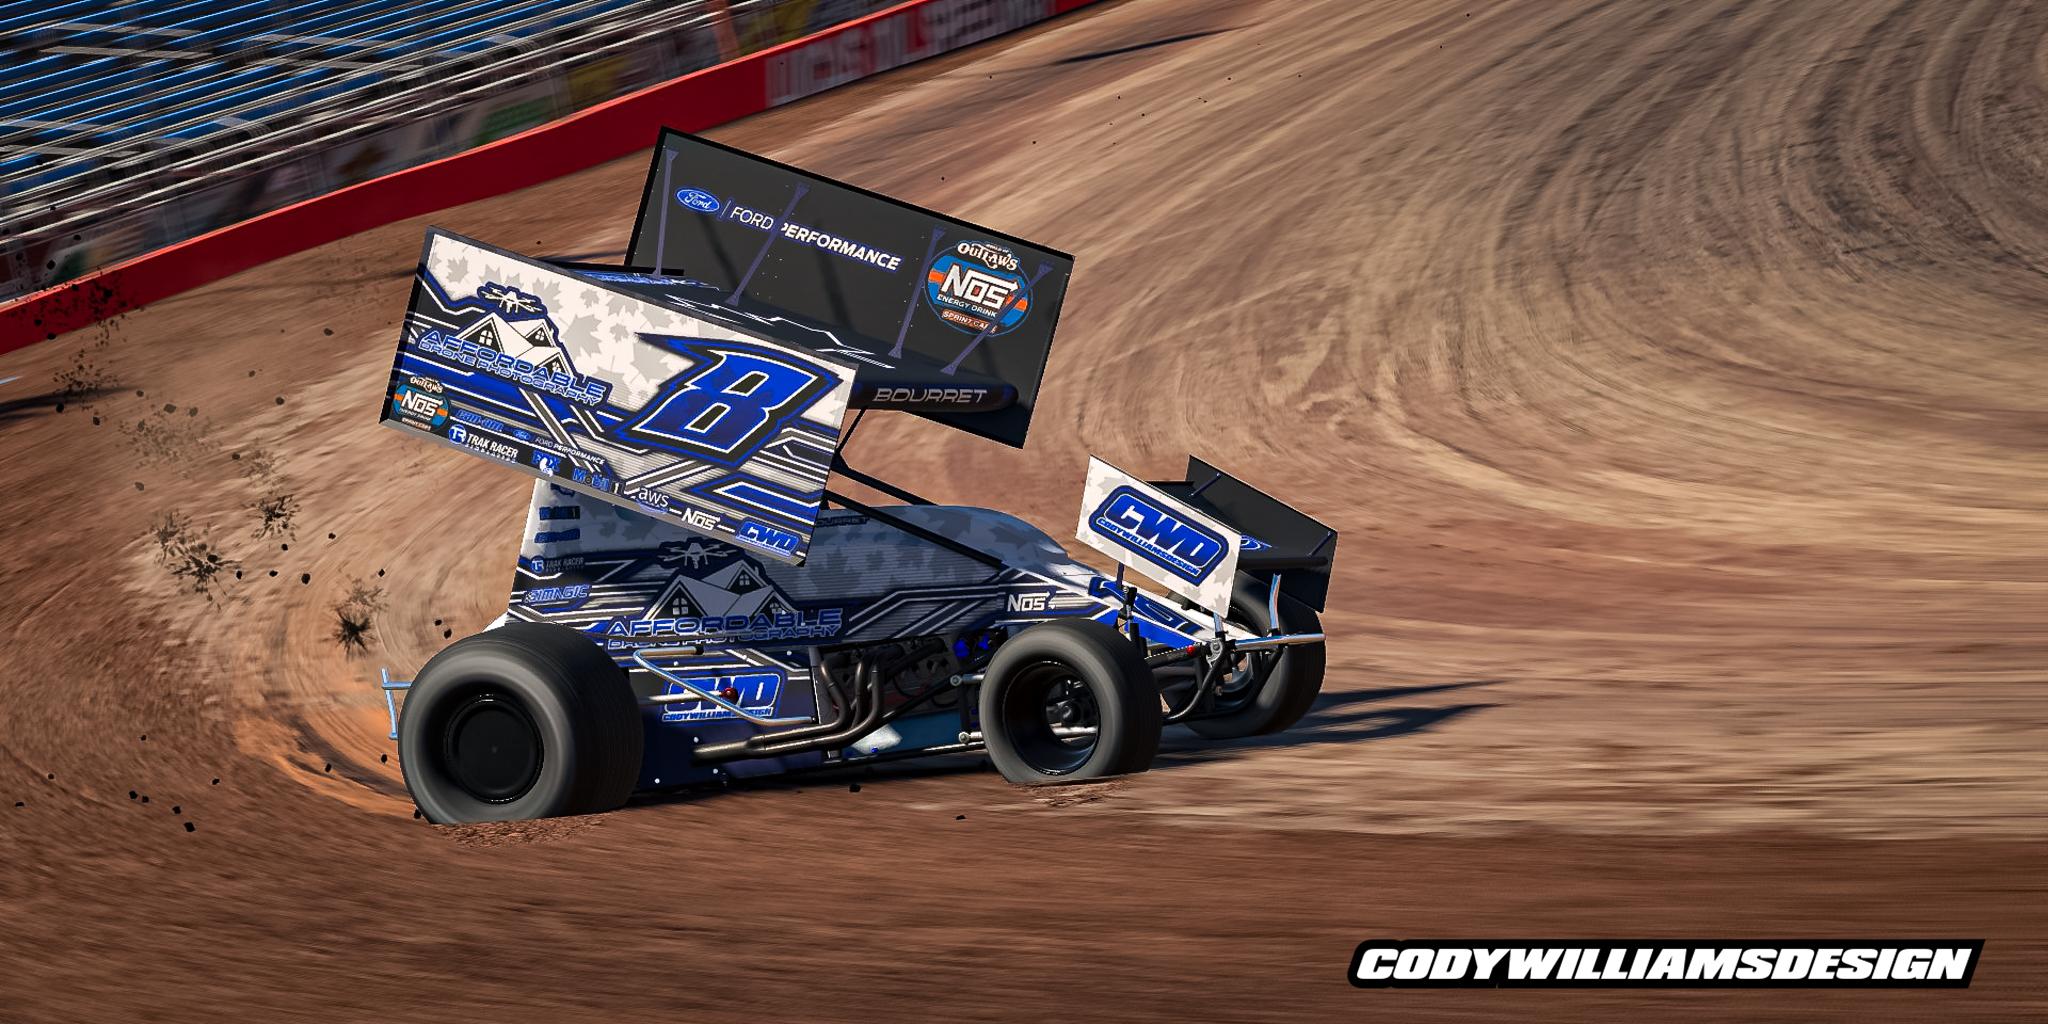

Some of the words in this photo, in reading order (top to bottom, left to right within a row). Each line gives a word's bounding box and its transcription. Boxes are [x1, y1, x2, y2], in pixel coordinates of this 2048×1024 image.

[683, 191, 711, 211] Ford
[730, 206, 774, 231] FORD
[941, 263, 1018, 310] NOS
[937, 293, 971, 309] ENERGY
[971, 304, 998, 318] DRINK
[941, 310, 972, 326] SPRINT
[418, 329, 607, 399] AFFORDABLE
[419, 339, 476, 368] DRONE
[478, 359, 605, 407] PHOTOGRAPHY
[401, 390, 443, 417] NOS
[632, 349, 819, 454] 8
[872, 387, 988, 404] BOURRET
[467, 433, 490, 450] TRAK
[490, 442, 519, 459] RACER
[638, 486, 670, 508] aws
[681, 507, 721, 532] NOS
[1105, 493, 1222, 568] CWD
[740, 521, 799, 555] CWD
[1096, 517, 1202, 577] CODYWILLIAMSDESIGN
[1007, 591, 1051, 612] NOS
[608, 608, 844, 637] AFFORDABLE
